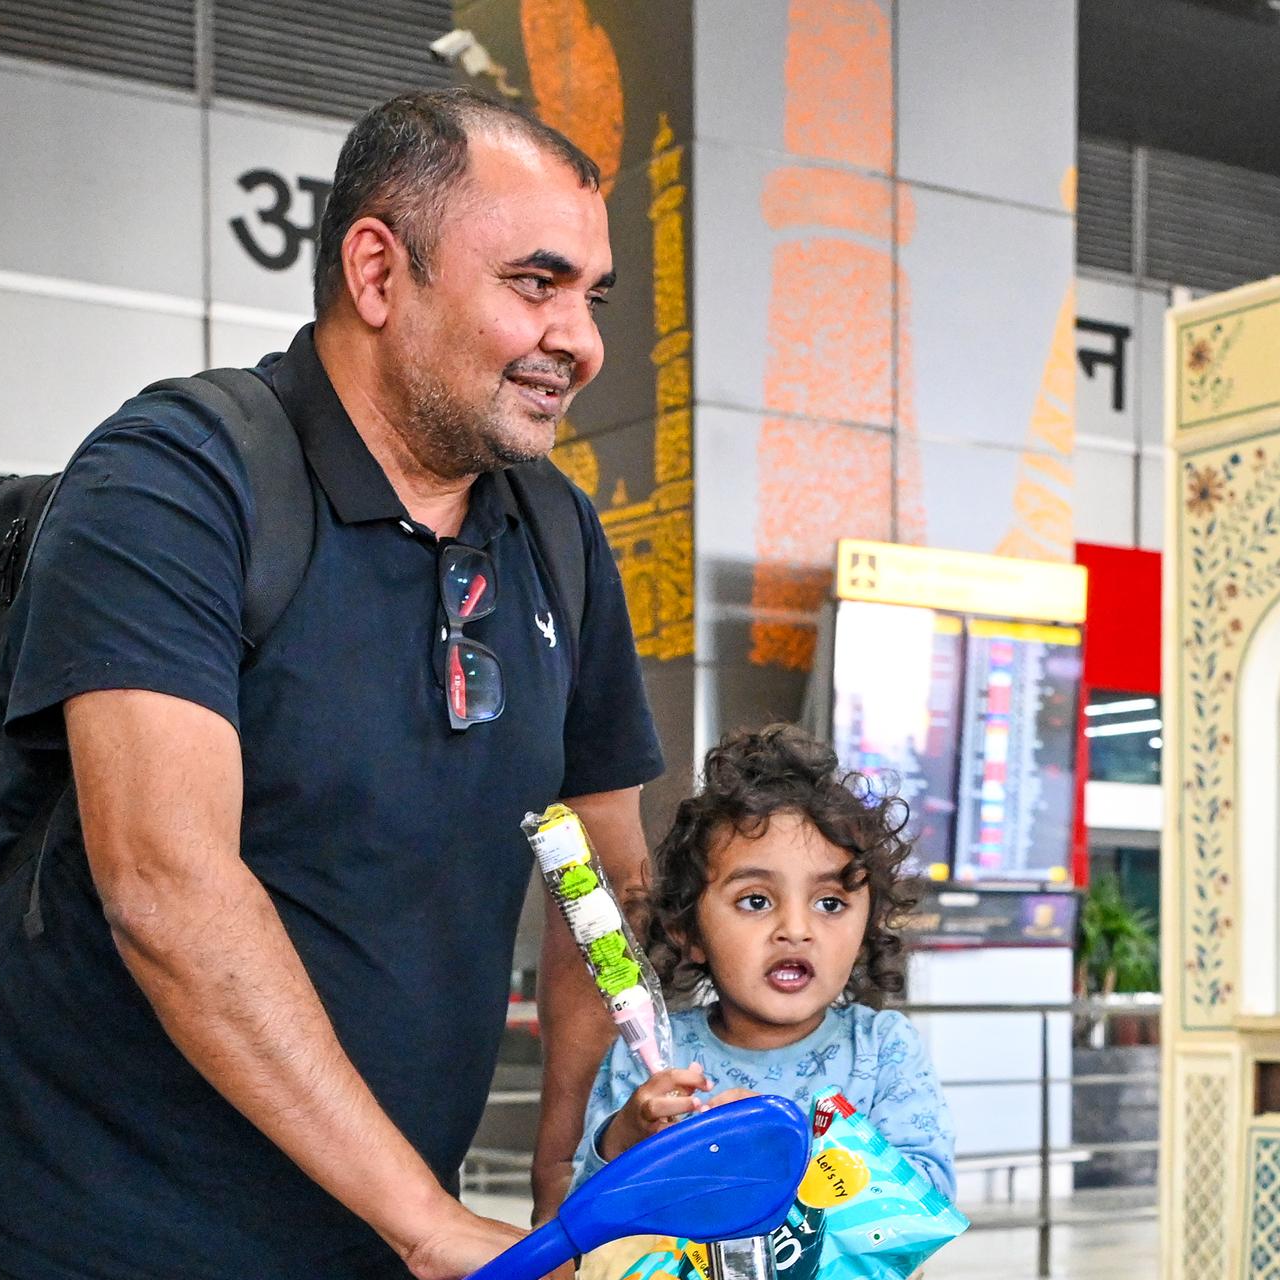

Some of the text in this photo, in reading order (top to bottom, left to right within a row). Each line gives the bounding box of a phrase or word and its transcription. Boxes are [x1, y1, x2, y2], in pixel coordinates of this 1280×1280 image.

[816, 1154, 849, 1199] Let's Try
[692, 1249, 704, 1266] ONLY
